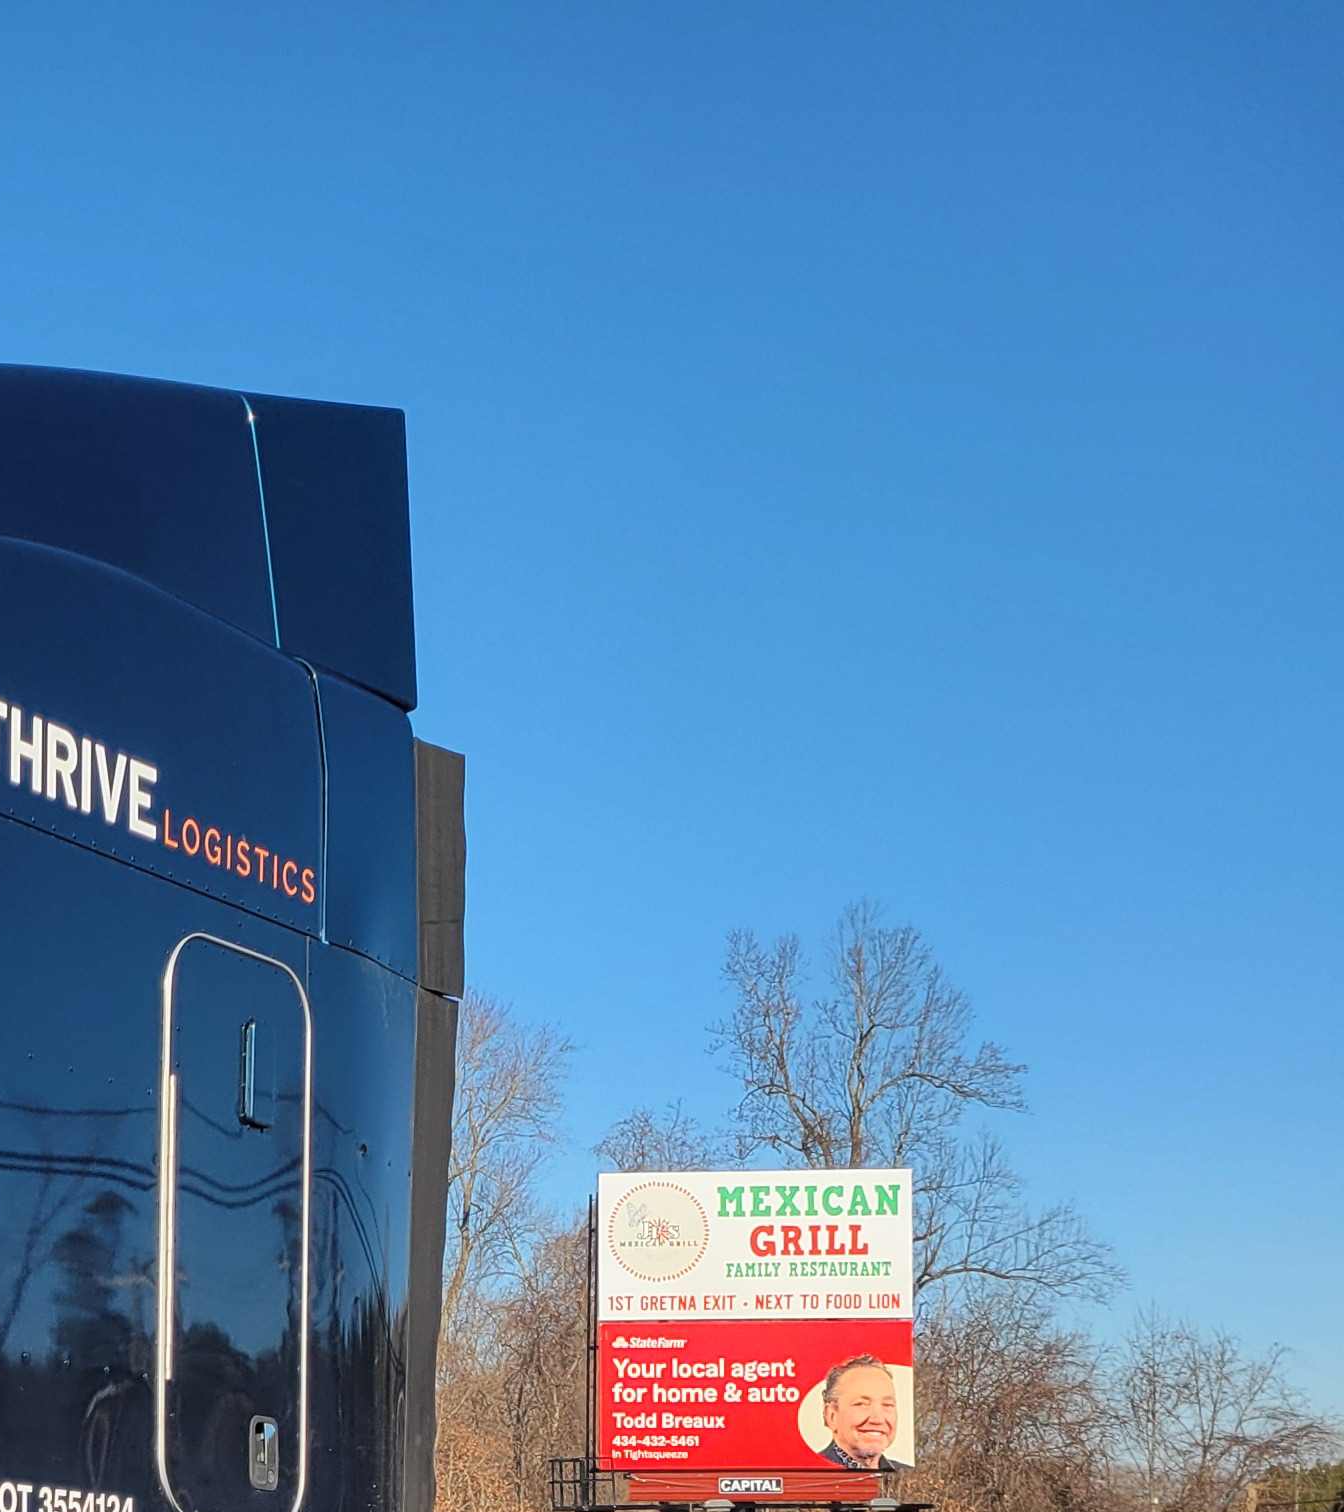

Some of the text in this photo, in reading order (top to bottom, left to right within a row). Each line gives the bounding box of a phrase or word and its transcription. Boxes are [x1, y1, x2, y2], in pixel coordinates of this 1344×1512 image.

[162, 808, 317, 904] LOGISTICS
[717, 1185, 900, 1217] MEXICAN
[750, 1225, 869, 1257] GRILL
[725, 1261, 892, 1278] FAMILY RESTAURANT
[608, 1293, 901, 1311] 1ST GRETNA EXIT NEXT TO FOOD LION
[612, 1357, 795, 1382] Your local agent
[611, 1383, 800, 1403] for home & auto
[612, 1412, 725, 1429] Todd Breaux
[624, 1449, 689, 1460] Tightsqueeze
[720, 1480, 780, 1492] CAPITAL
